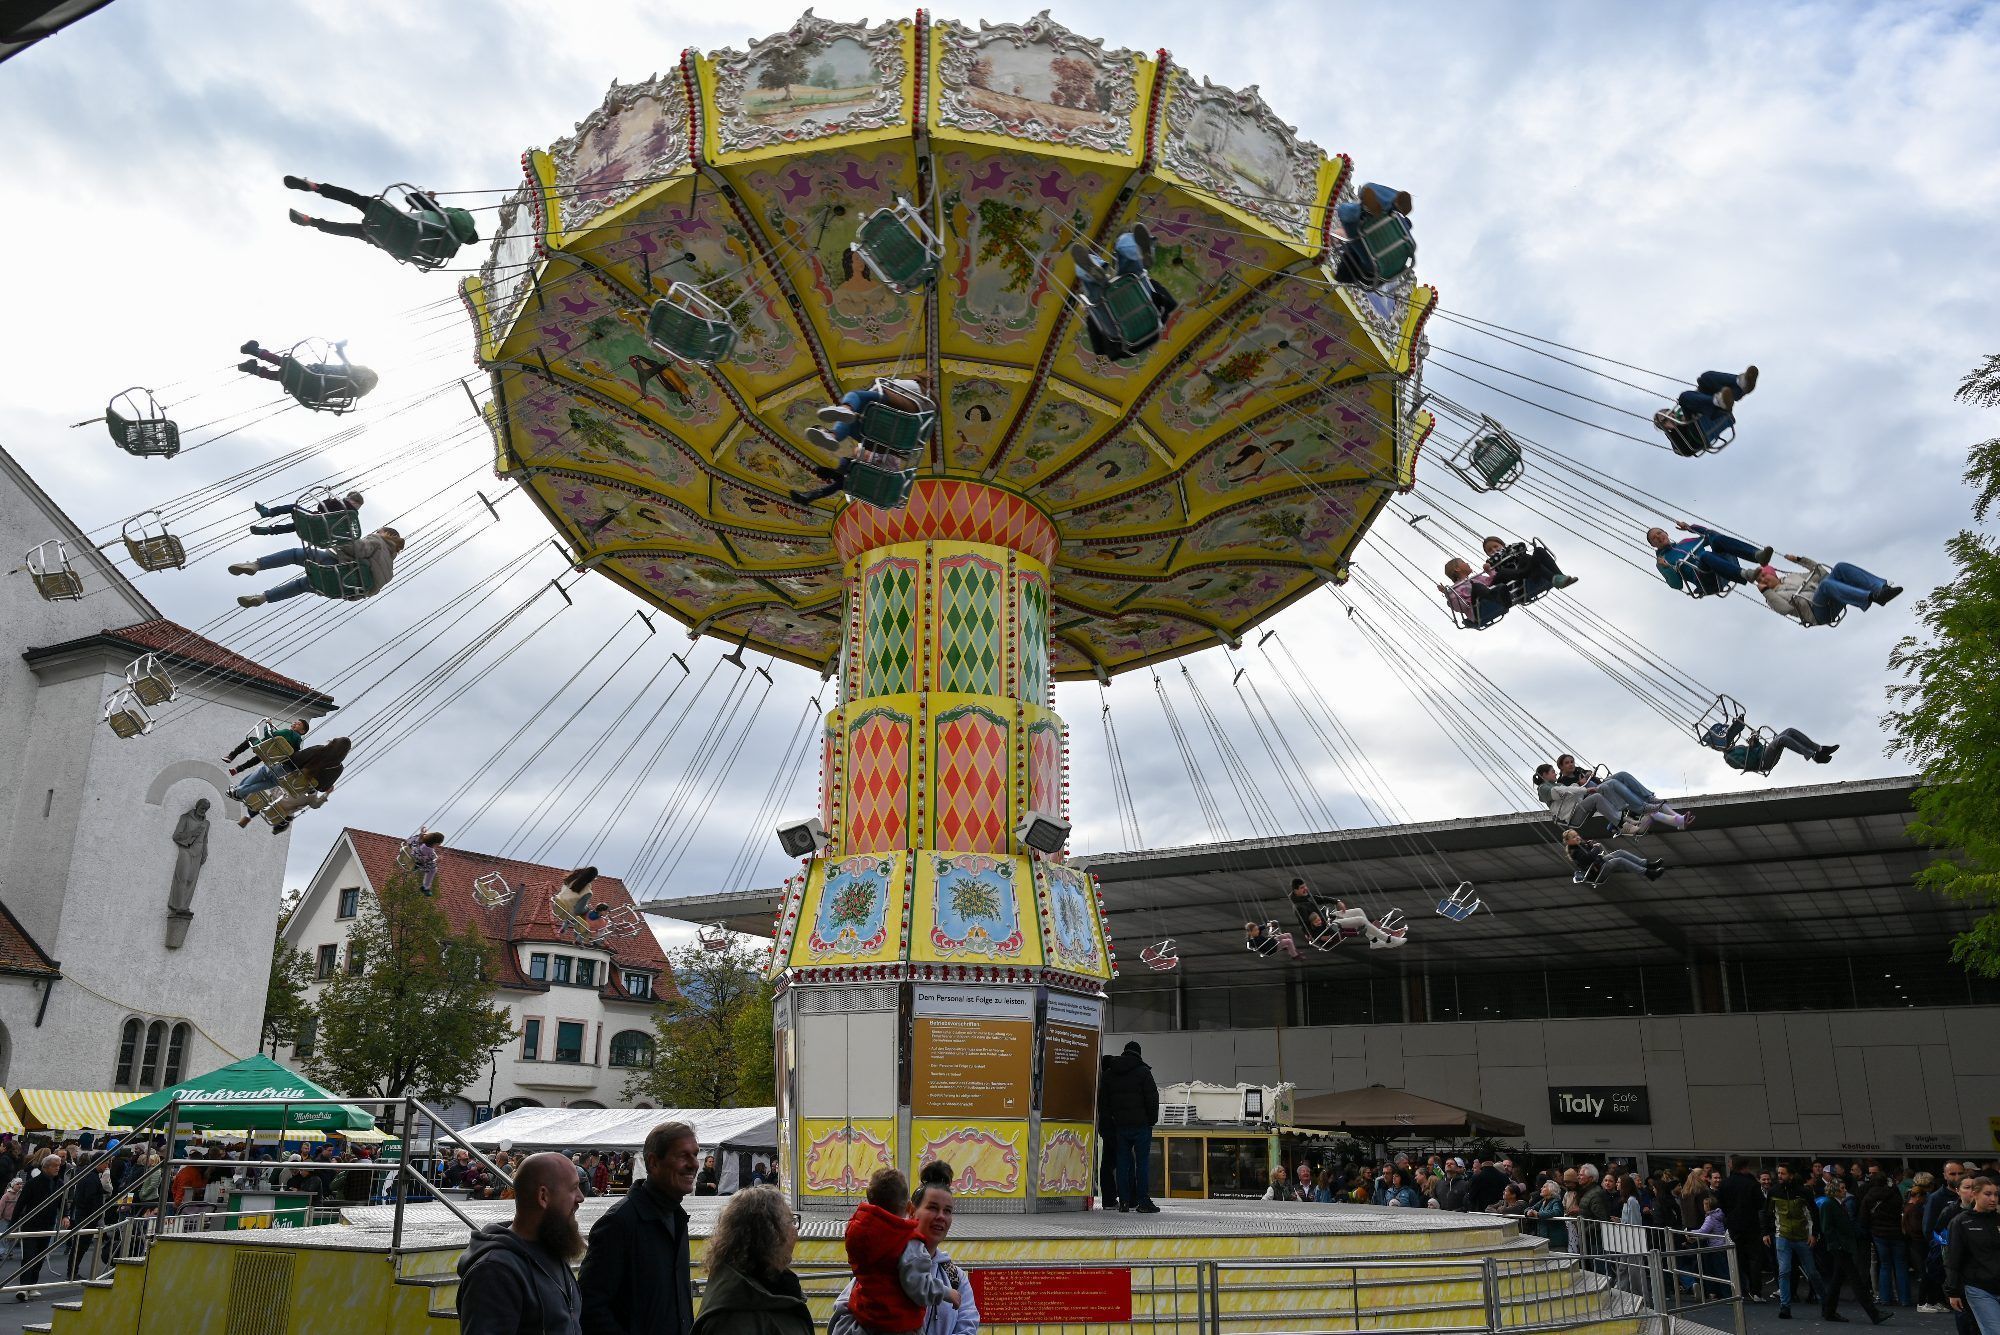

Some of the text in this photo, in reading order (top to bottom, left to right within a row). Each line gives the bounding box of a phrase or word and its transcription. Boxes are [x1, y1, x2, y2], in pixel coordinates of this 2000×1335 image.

[918, 993, 934, 1001] Dem
[936, 994, 964, 1003] Personal
[966, 995, 974, 1003] ist
[975, 995, 993, 1005] Folge
[172, 1087, 305, 1101] Mohrenbräu
[1558, 1093, 1605, 1118] iTaly
[1613, 1103, 1630, 1112] Bar
[293, 1111, 333, 1121] Mohrenbräu
